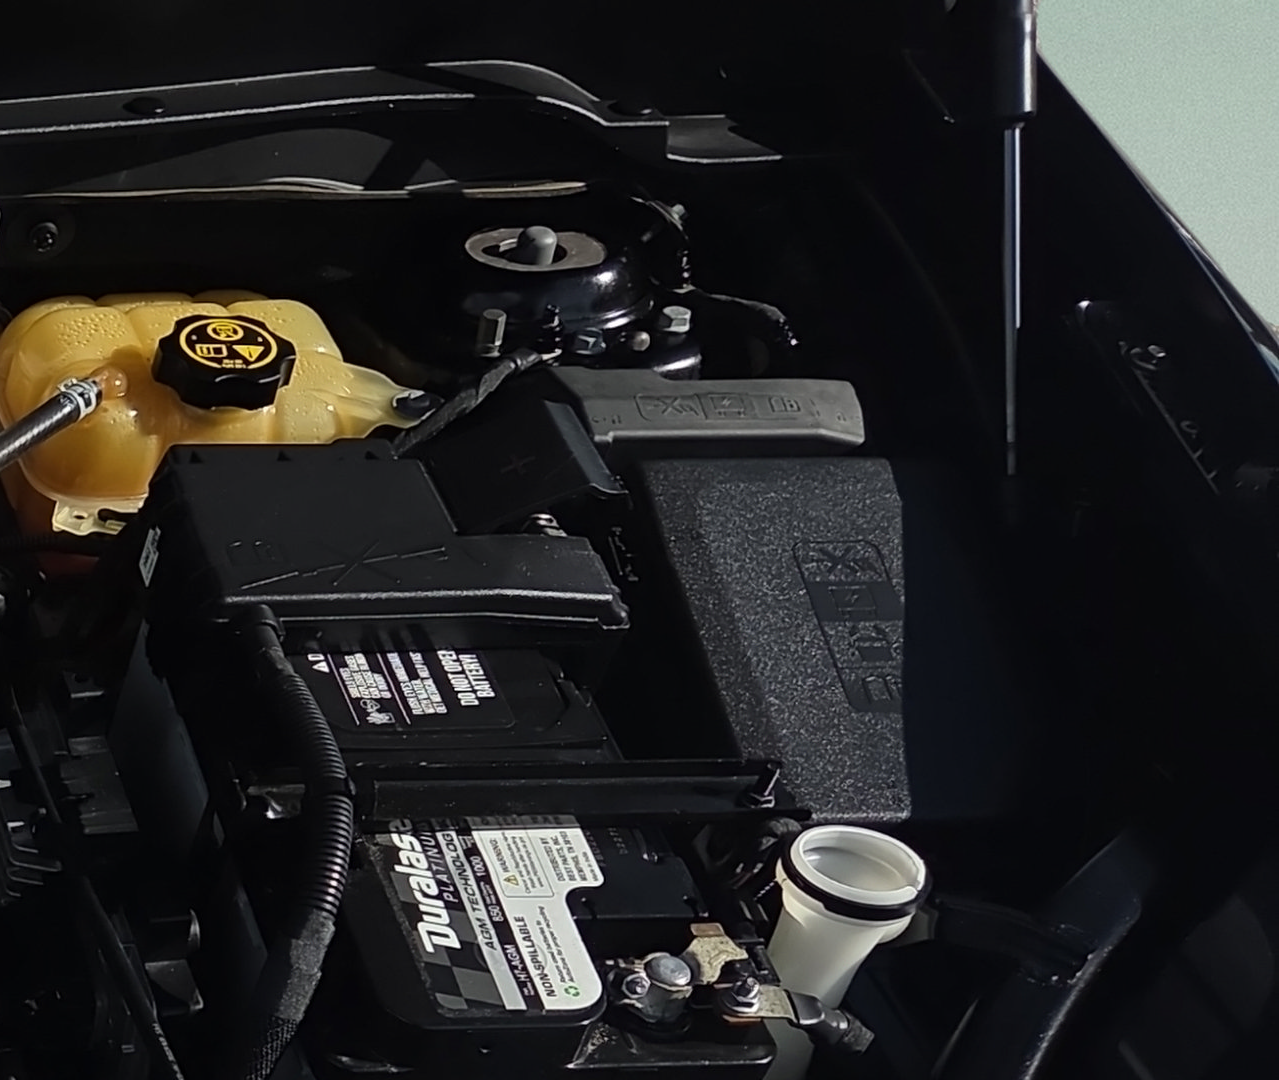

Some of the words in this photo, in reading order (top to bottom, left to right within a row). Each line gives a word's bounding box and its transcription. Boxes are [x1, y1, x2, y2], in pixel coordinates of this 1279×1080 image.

[447, 673, 473, 691] NOT
[457, 692, 480, 706] DO
[419, 832, 459, 903] PLATINU
[443, 832, 483, 913] TECHNOLOG
[470, 855, 487, 877] 1000
[391, 832, 462, 953] Duralas
[488, 904, 504, 922] 850
[475, 917, 498, 951] AGM
